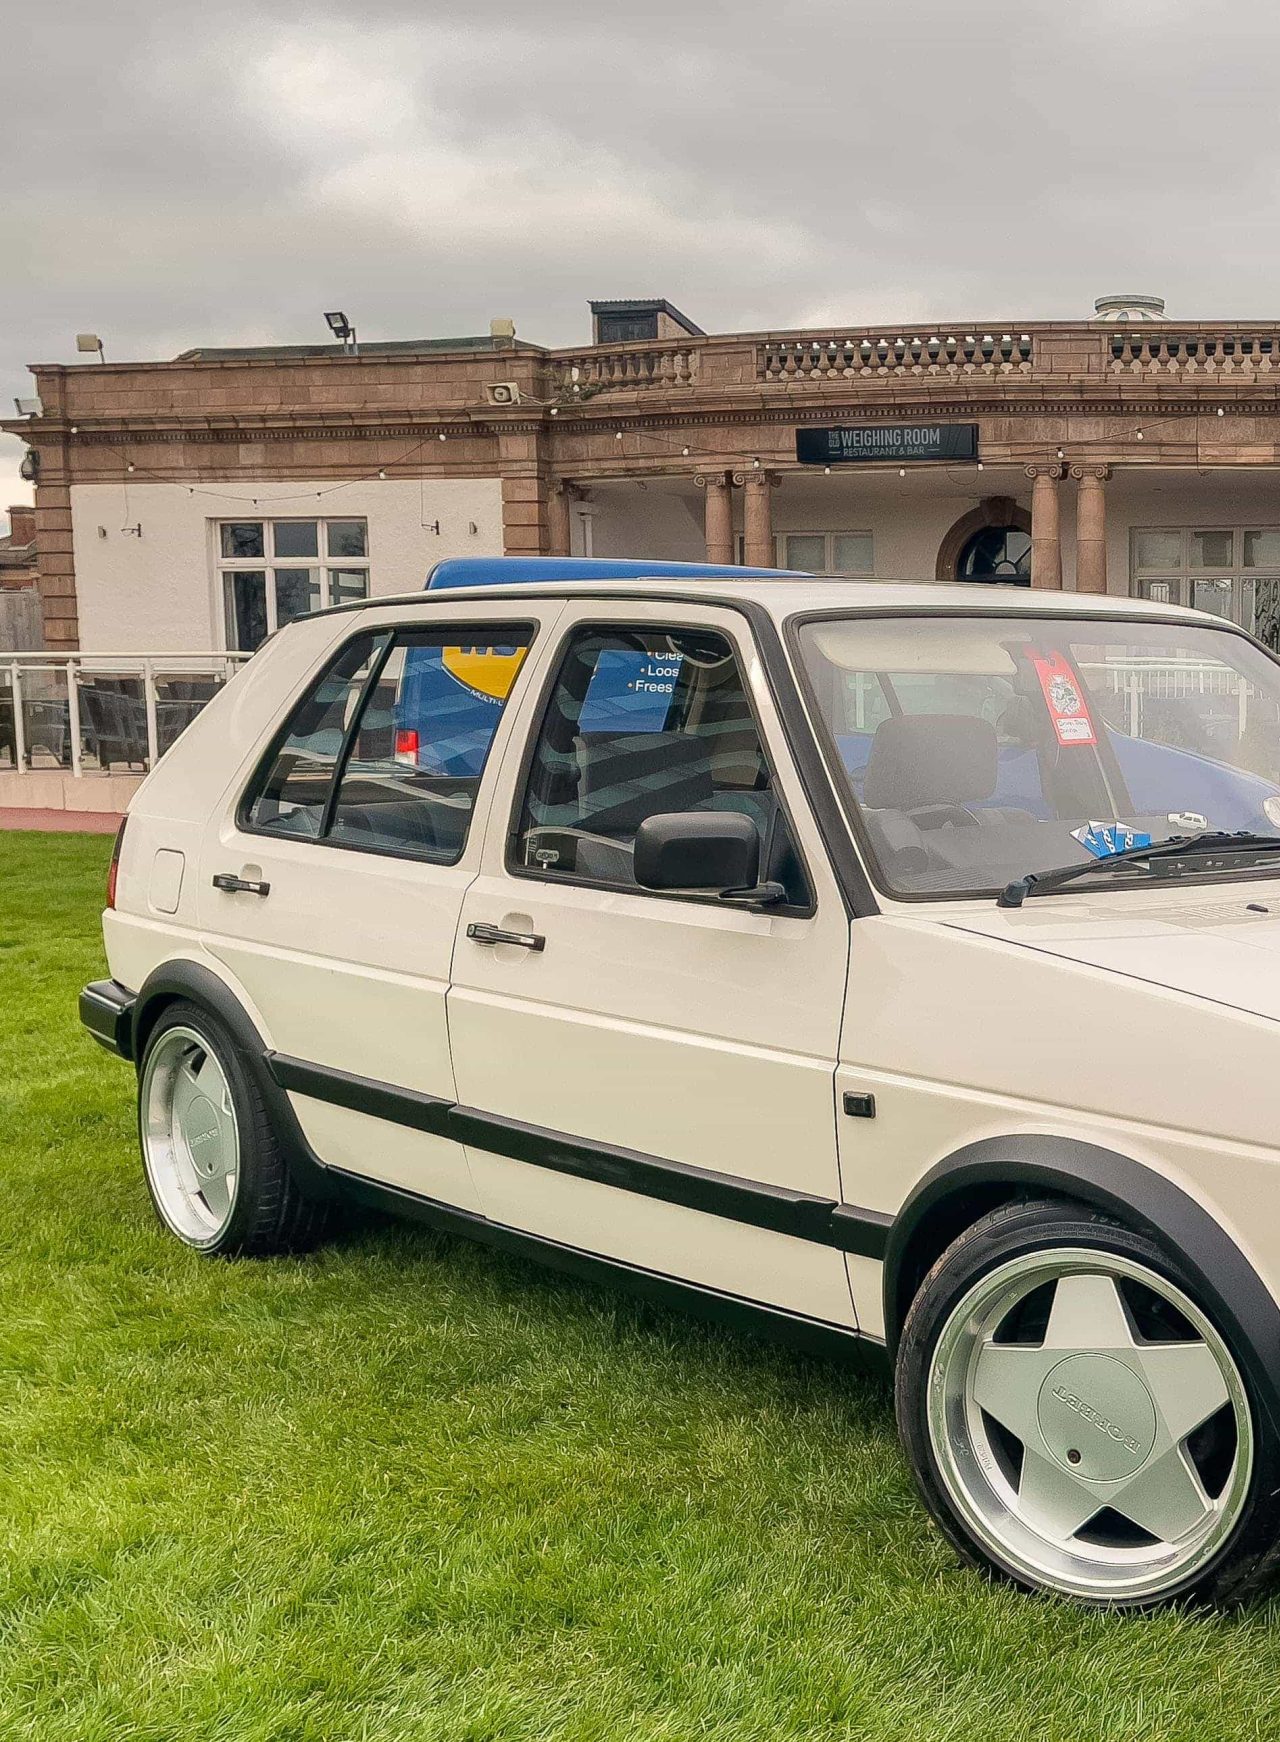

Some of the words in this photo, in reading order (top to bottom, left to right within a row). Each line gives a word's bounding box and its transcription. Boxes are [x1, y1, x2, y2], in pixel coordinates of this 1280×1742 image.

[841, 430, 901, 447] WEIGHING
[905, 428, 941, 445] ROOM
[843, 446, 897, 457] RESTAURANT
[898, 446, 905, 455] &
[907, 446, 925, 455] BAR
[647, 664, 680, 677] Loos
[635, 680, 673, 693] Frees
